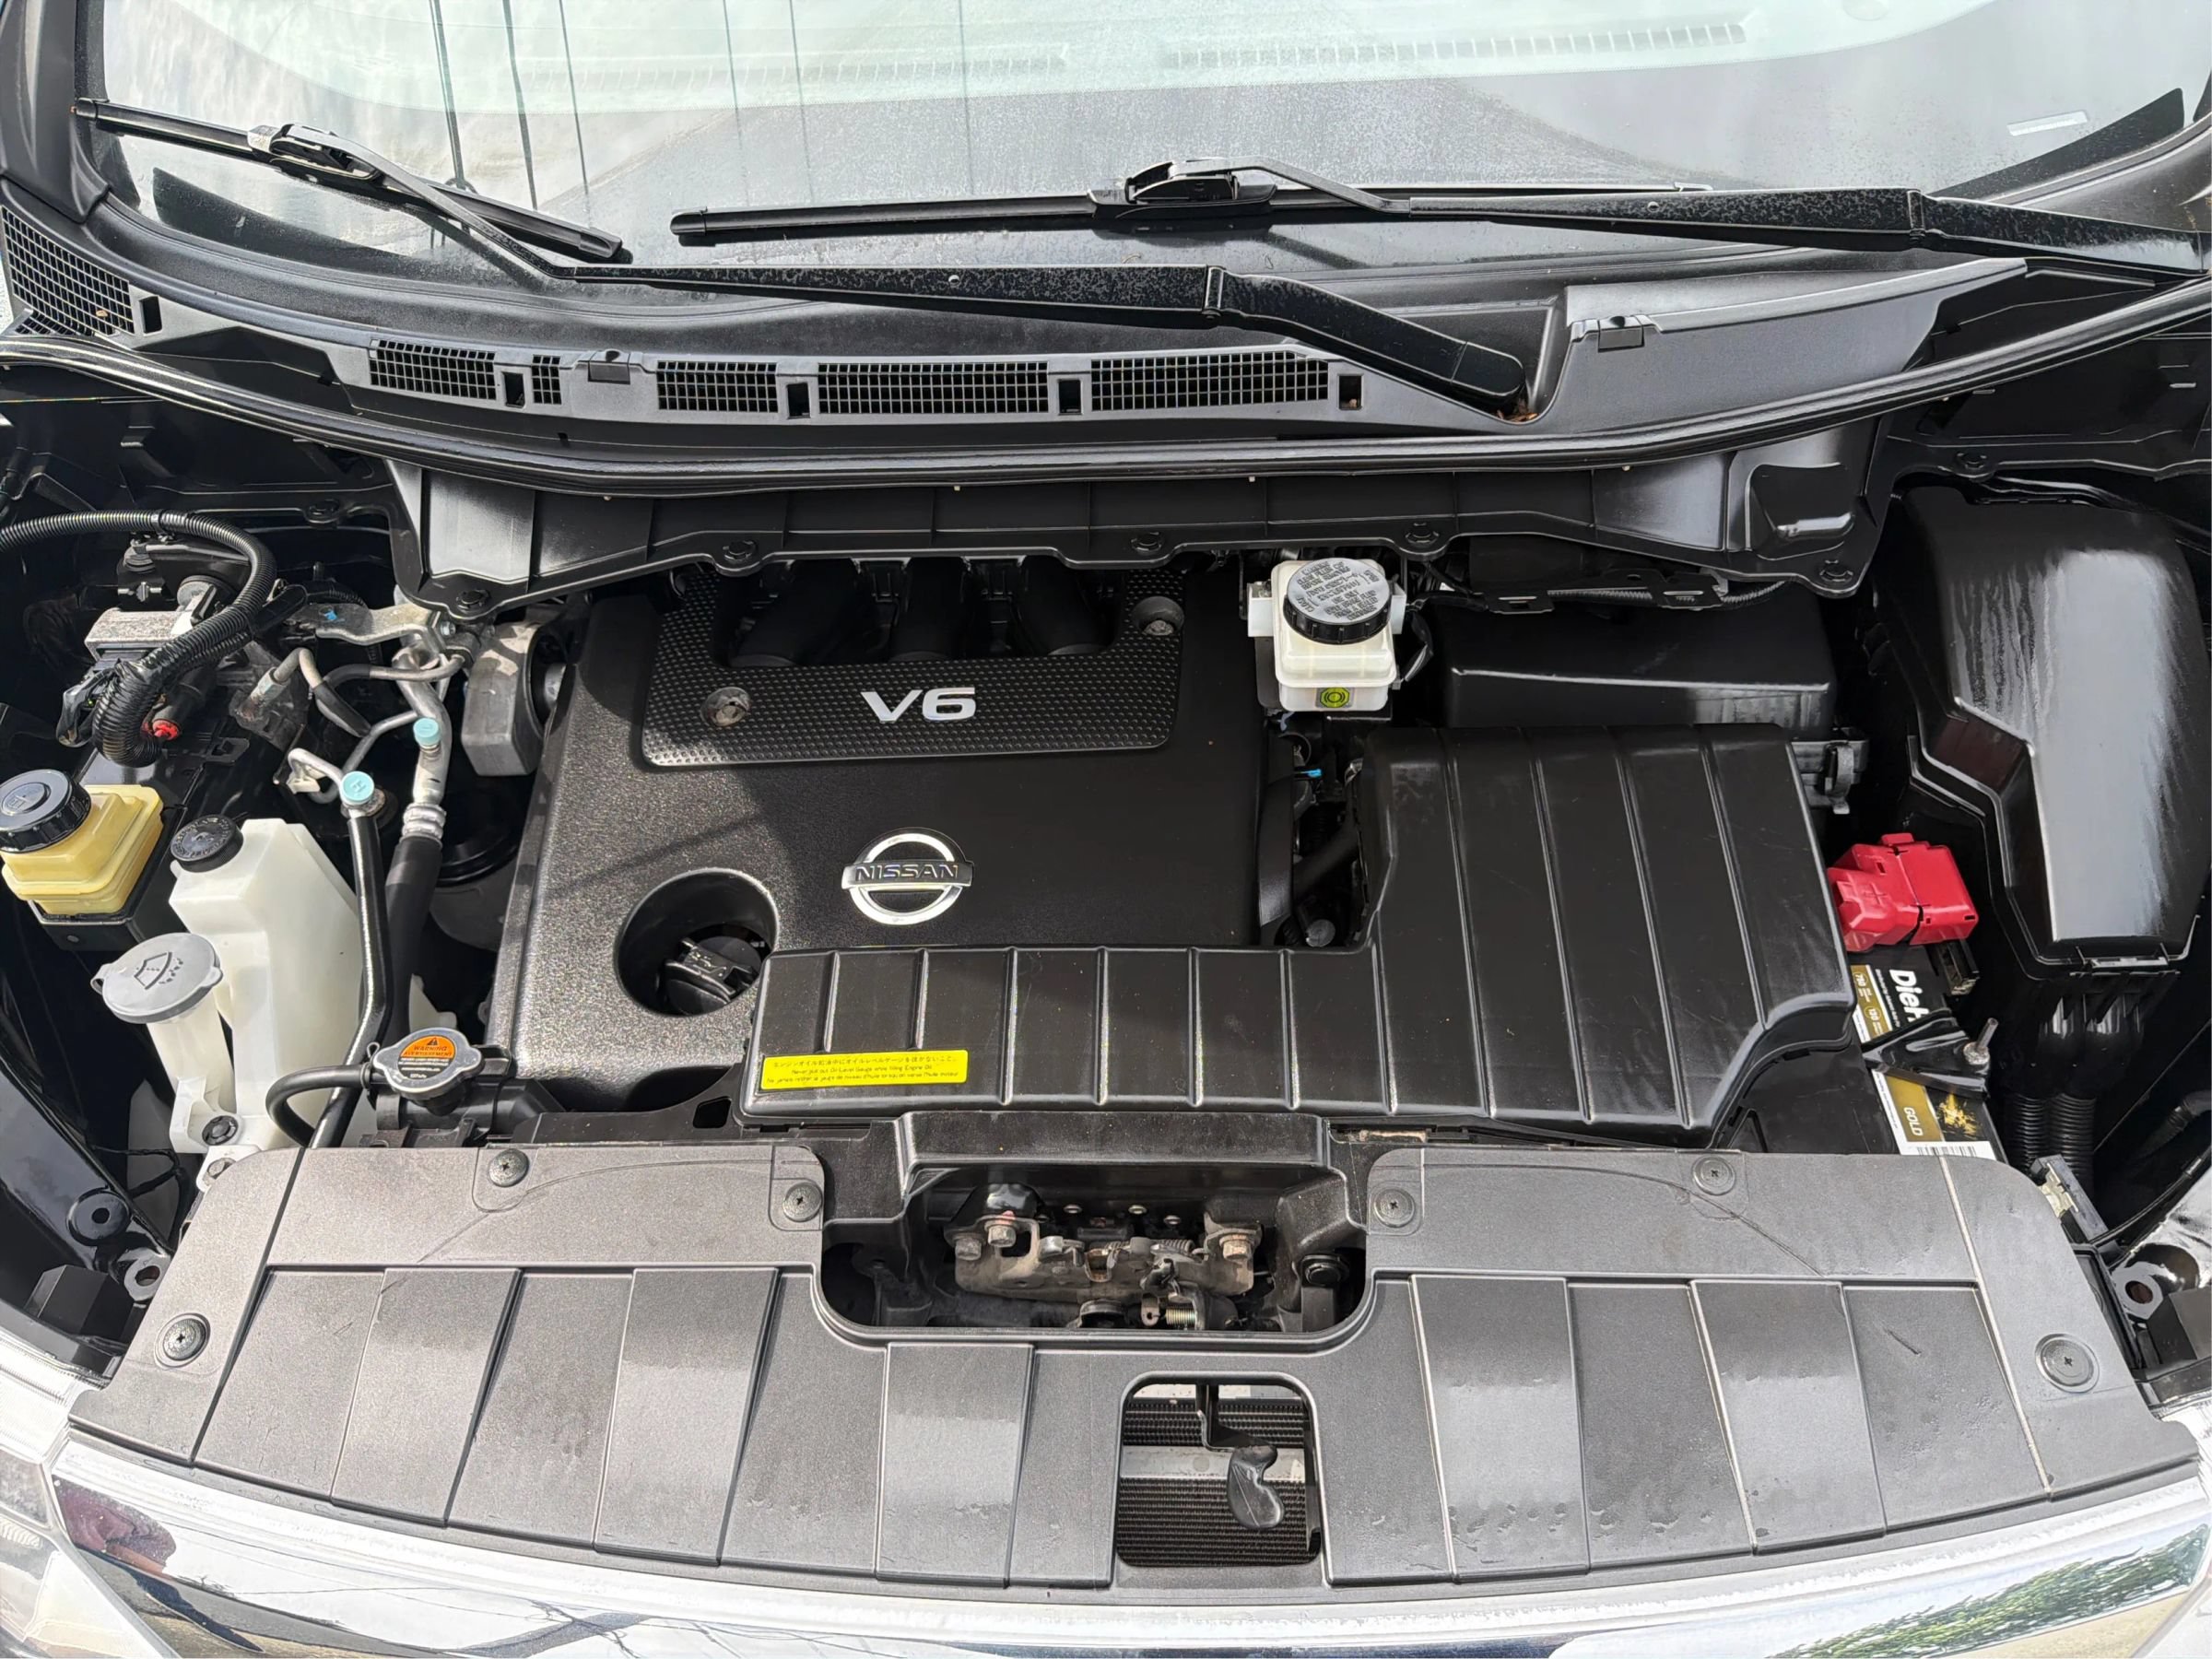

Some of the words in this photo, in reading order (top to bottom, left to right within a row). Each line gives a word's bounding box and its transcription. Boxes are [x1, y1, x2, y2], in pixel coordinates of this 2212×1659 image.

[860, 687, 977, 723] V6
[855, 864, 959, 882] NISSAN
[1903, 1107, 1924, 1136] GOLD
